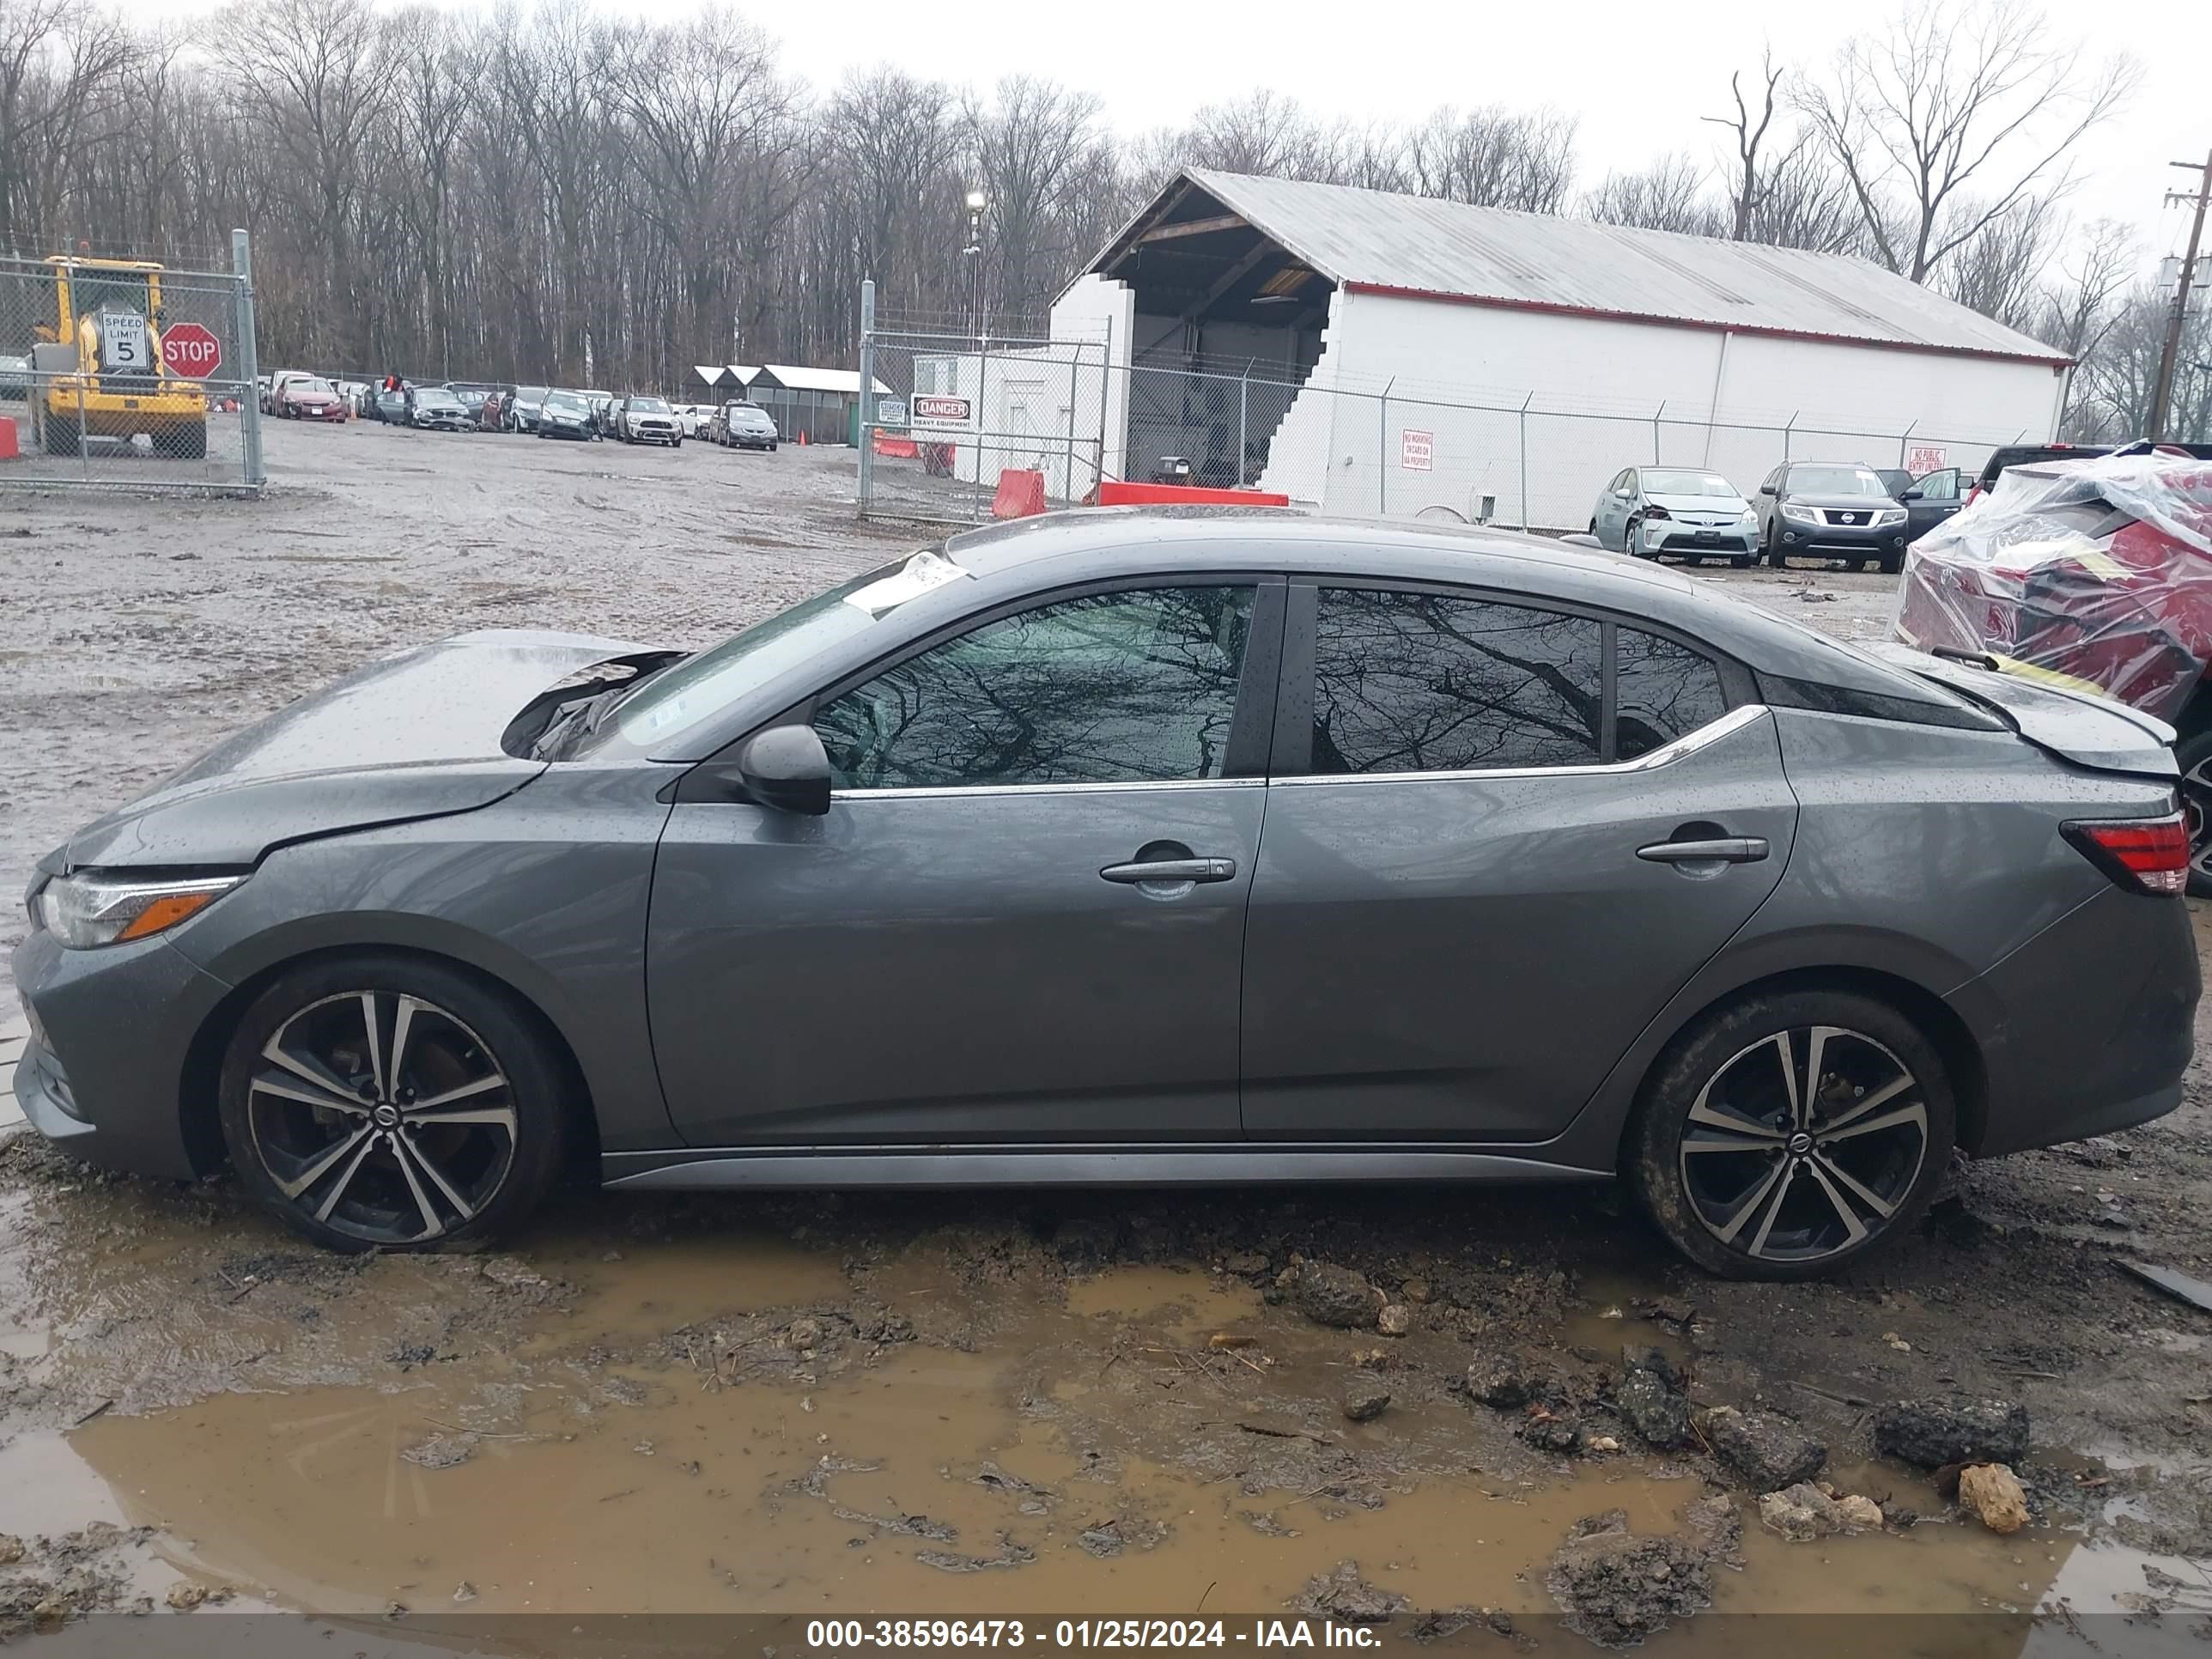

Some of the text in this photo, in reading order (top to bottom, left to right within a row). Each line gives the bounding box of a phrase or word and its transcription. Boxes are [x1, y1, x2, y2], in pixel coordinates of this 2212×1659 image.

[105, 318, 143, 328] SPEED
[110, 330, 138, 339] LIMIT
[118, 342, 135, 362] 5
[166, 340, 216, 362] STOP
[921, 401, 965, 416] DANGER
[936, 419, 970, 428] EQUIPMENT
[1405, 434, 1431, 445] NO WORKING
[1915, 450, 1941, 461] NO PUBLIC
[1411, 456, 1431, 467] PROPERTY
[1910, 462, 1924, 471] ENTRY
